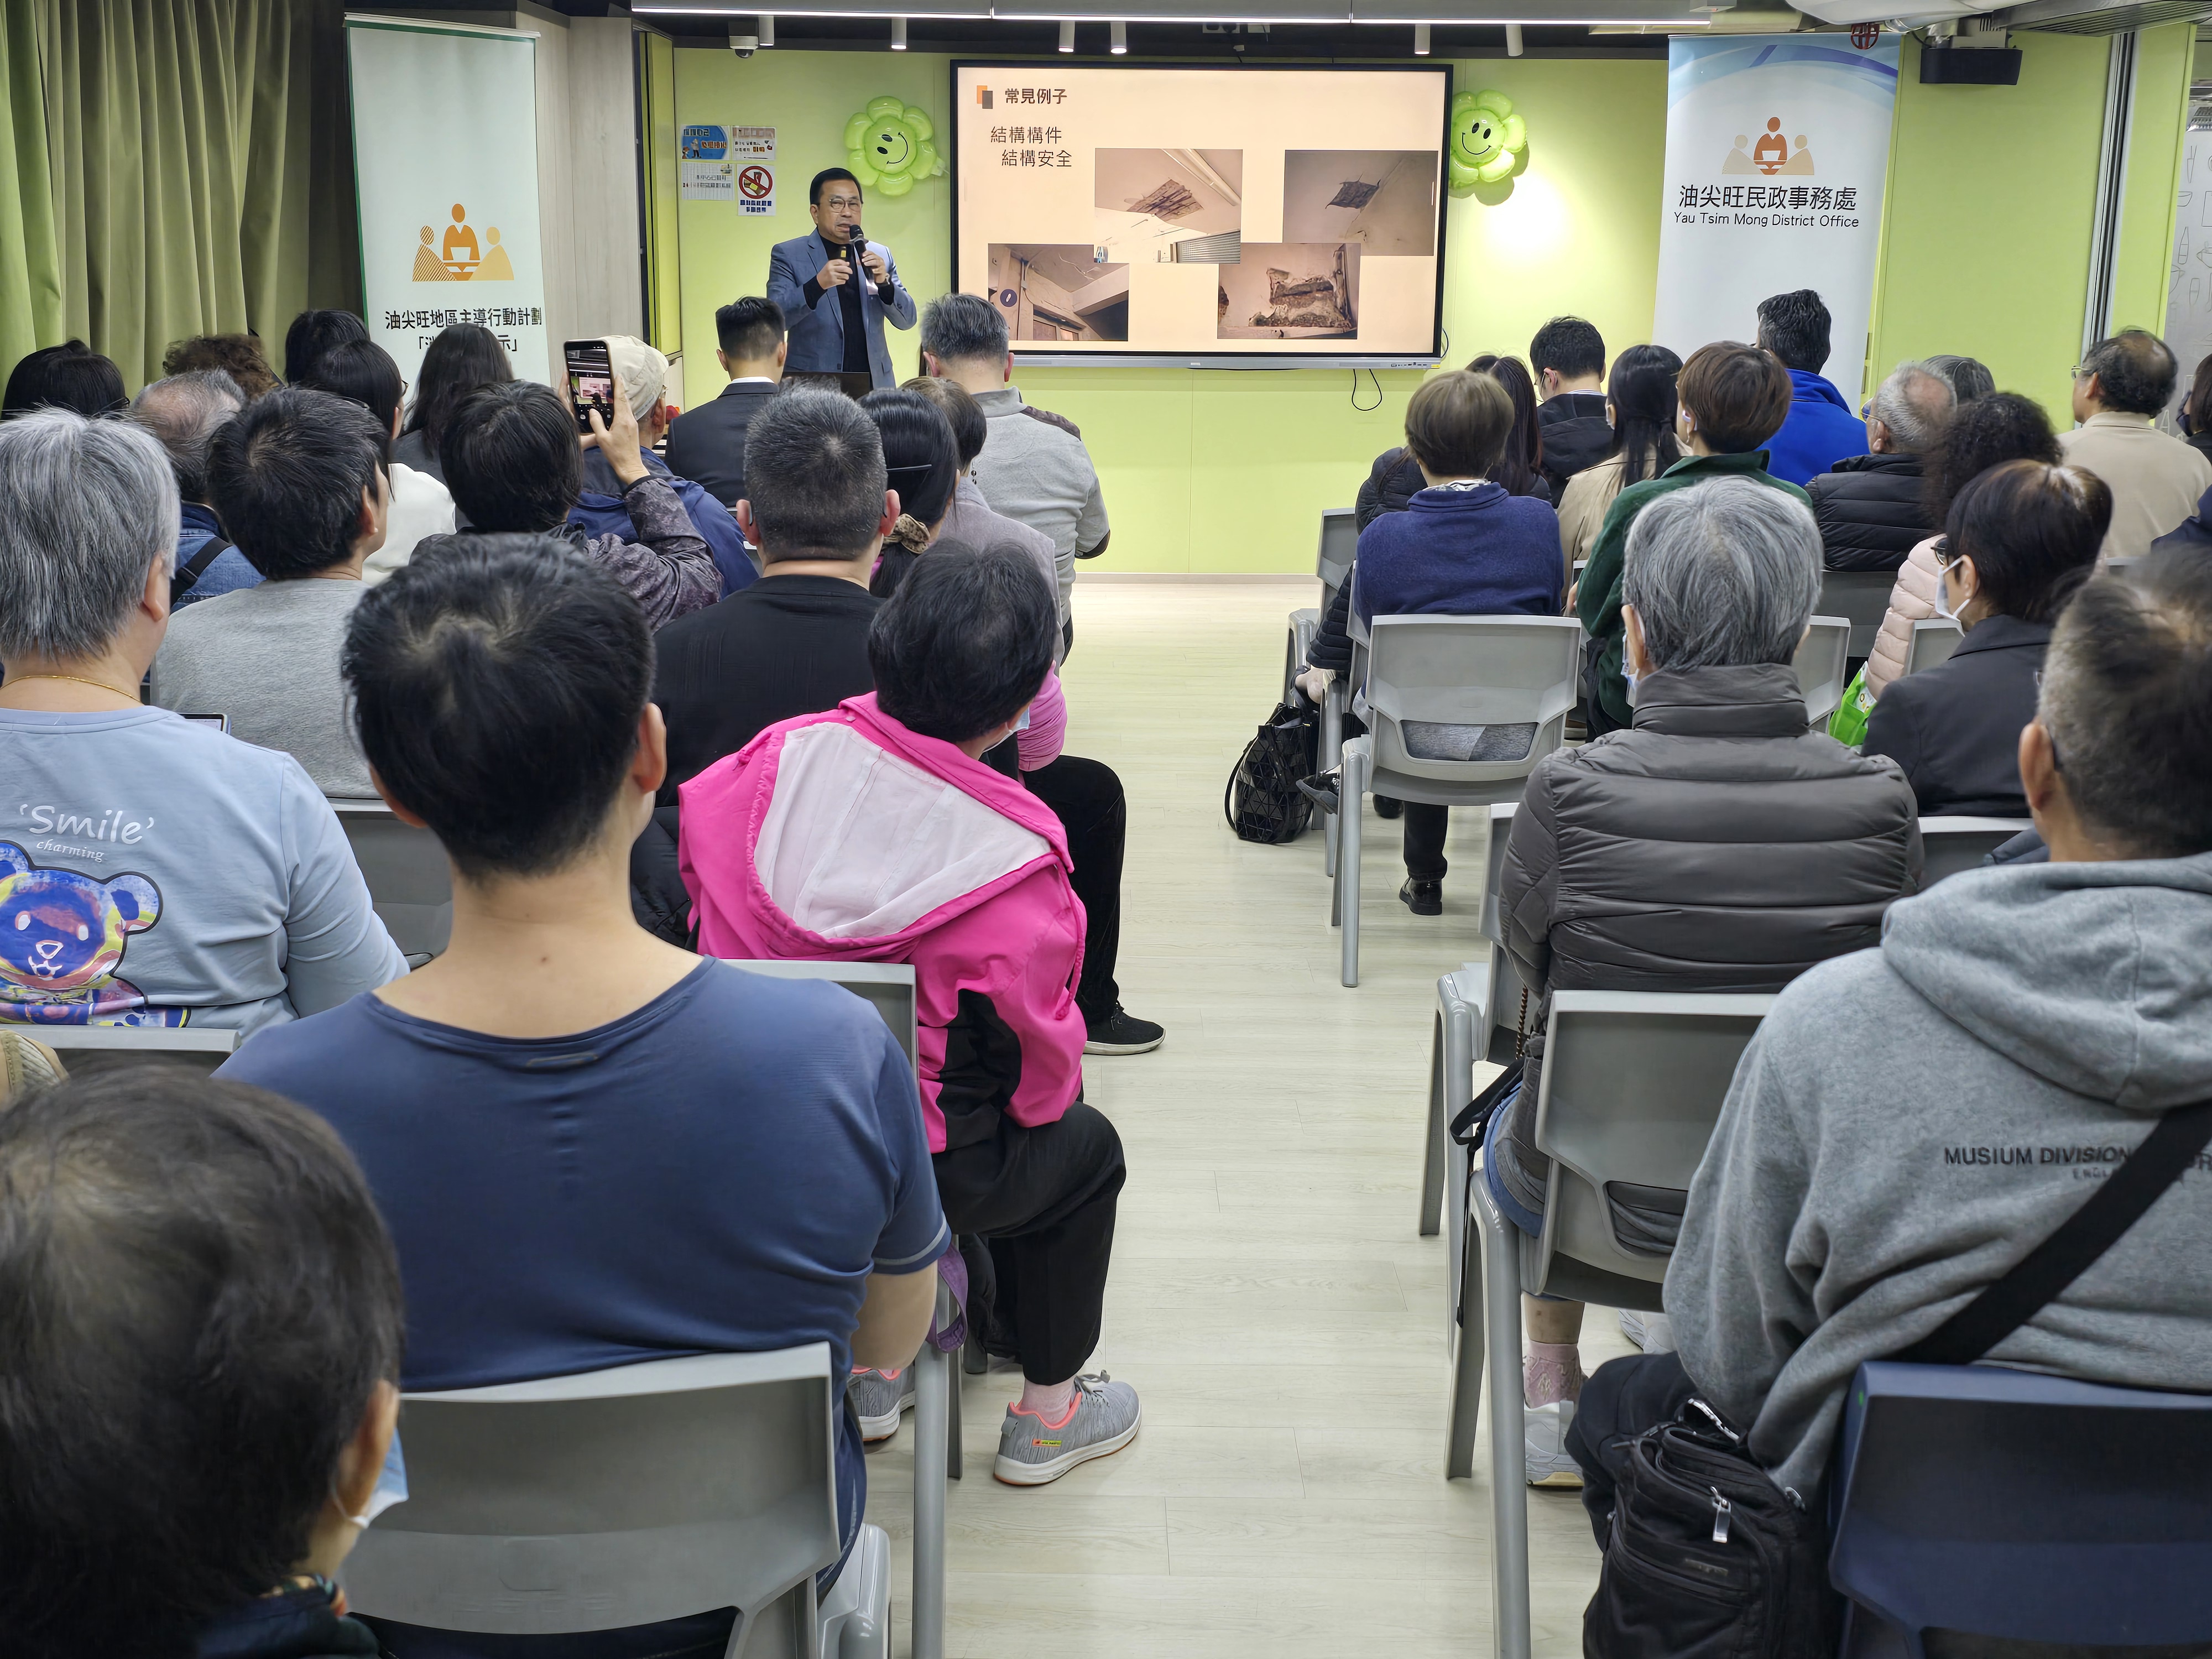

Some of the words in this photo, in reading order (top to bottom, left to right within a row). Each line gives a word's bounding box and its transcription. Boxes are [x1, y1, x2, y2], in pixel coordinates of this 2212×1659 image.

[1005, 88, 1067, 105] 常見例子
[990, 126, 1062, 144] 結構構件
[1001, 149, 1072, 167] 結構安全
[1679, 185, 1857, 211] 油尖旺民政事務處
[1674, 212, 1695, 223] Yau
[1700, 212, 1729, 225] Tsim
[1734, 213, 1768, 227] Mong
[1772, 214, 1814, 227] District
[1819, 215, 1859, 228] Office
[385, 307, 542, 330] 油尖旺地區主導行動計劃
[36, 839, 105, 863] charming
[1944, 1147, 2033, 1165] MUSIUM
